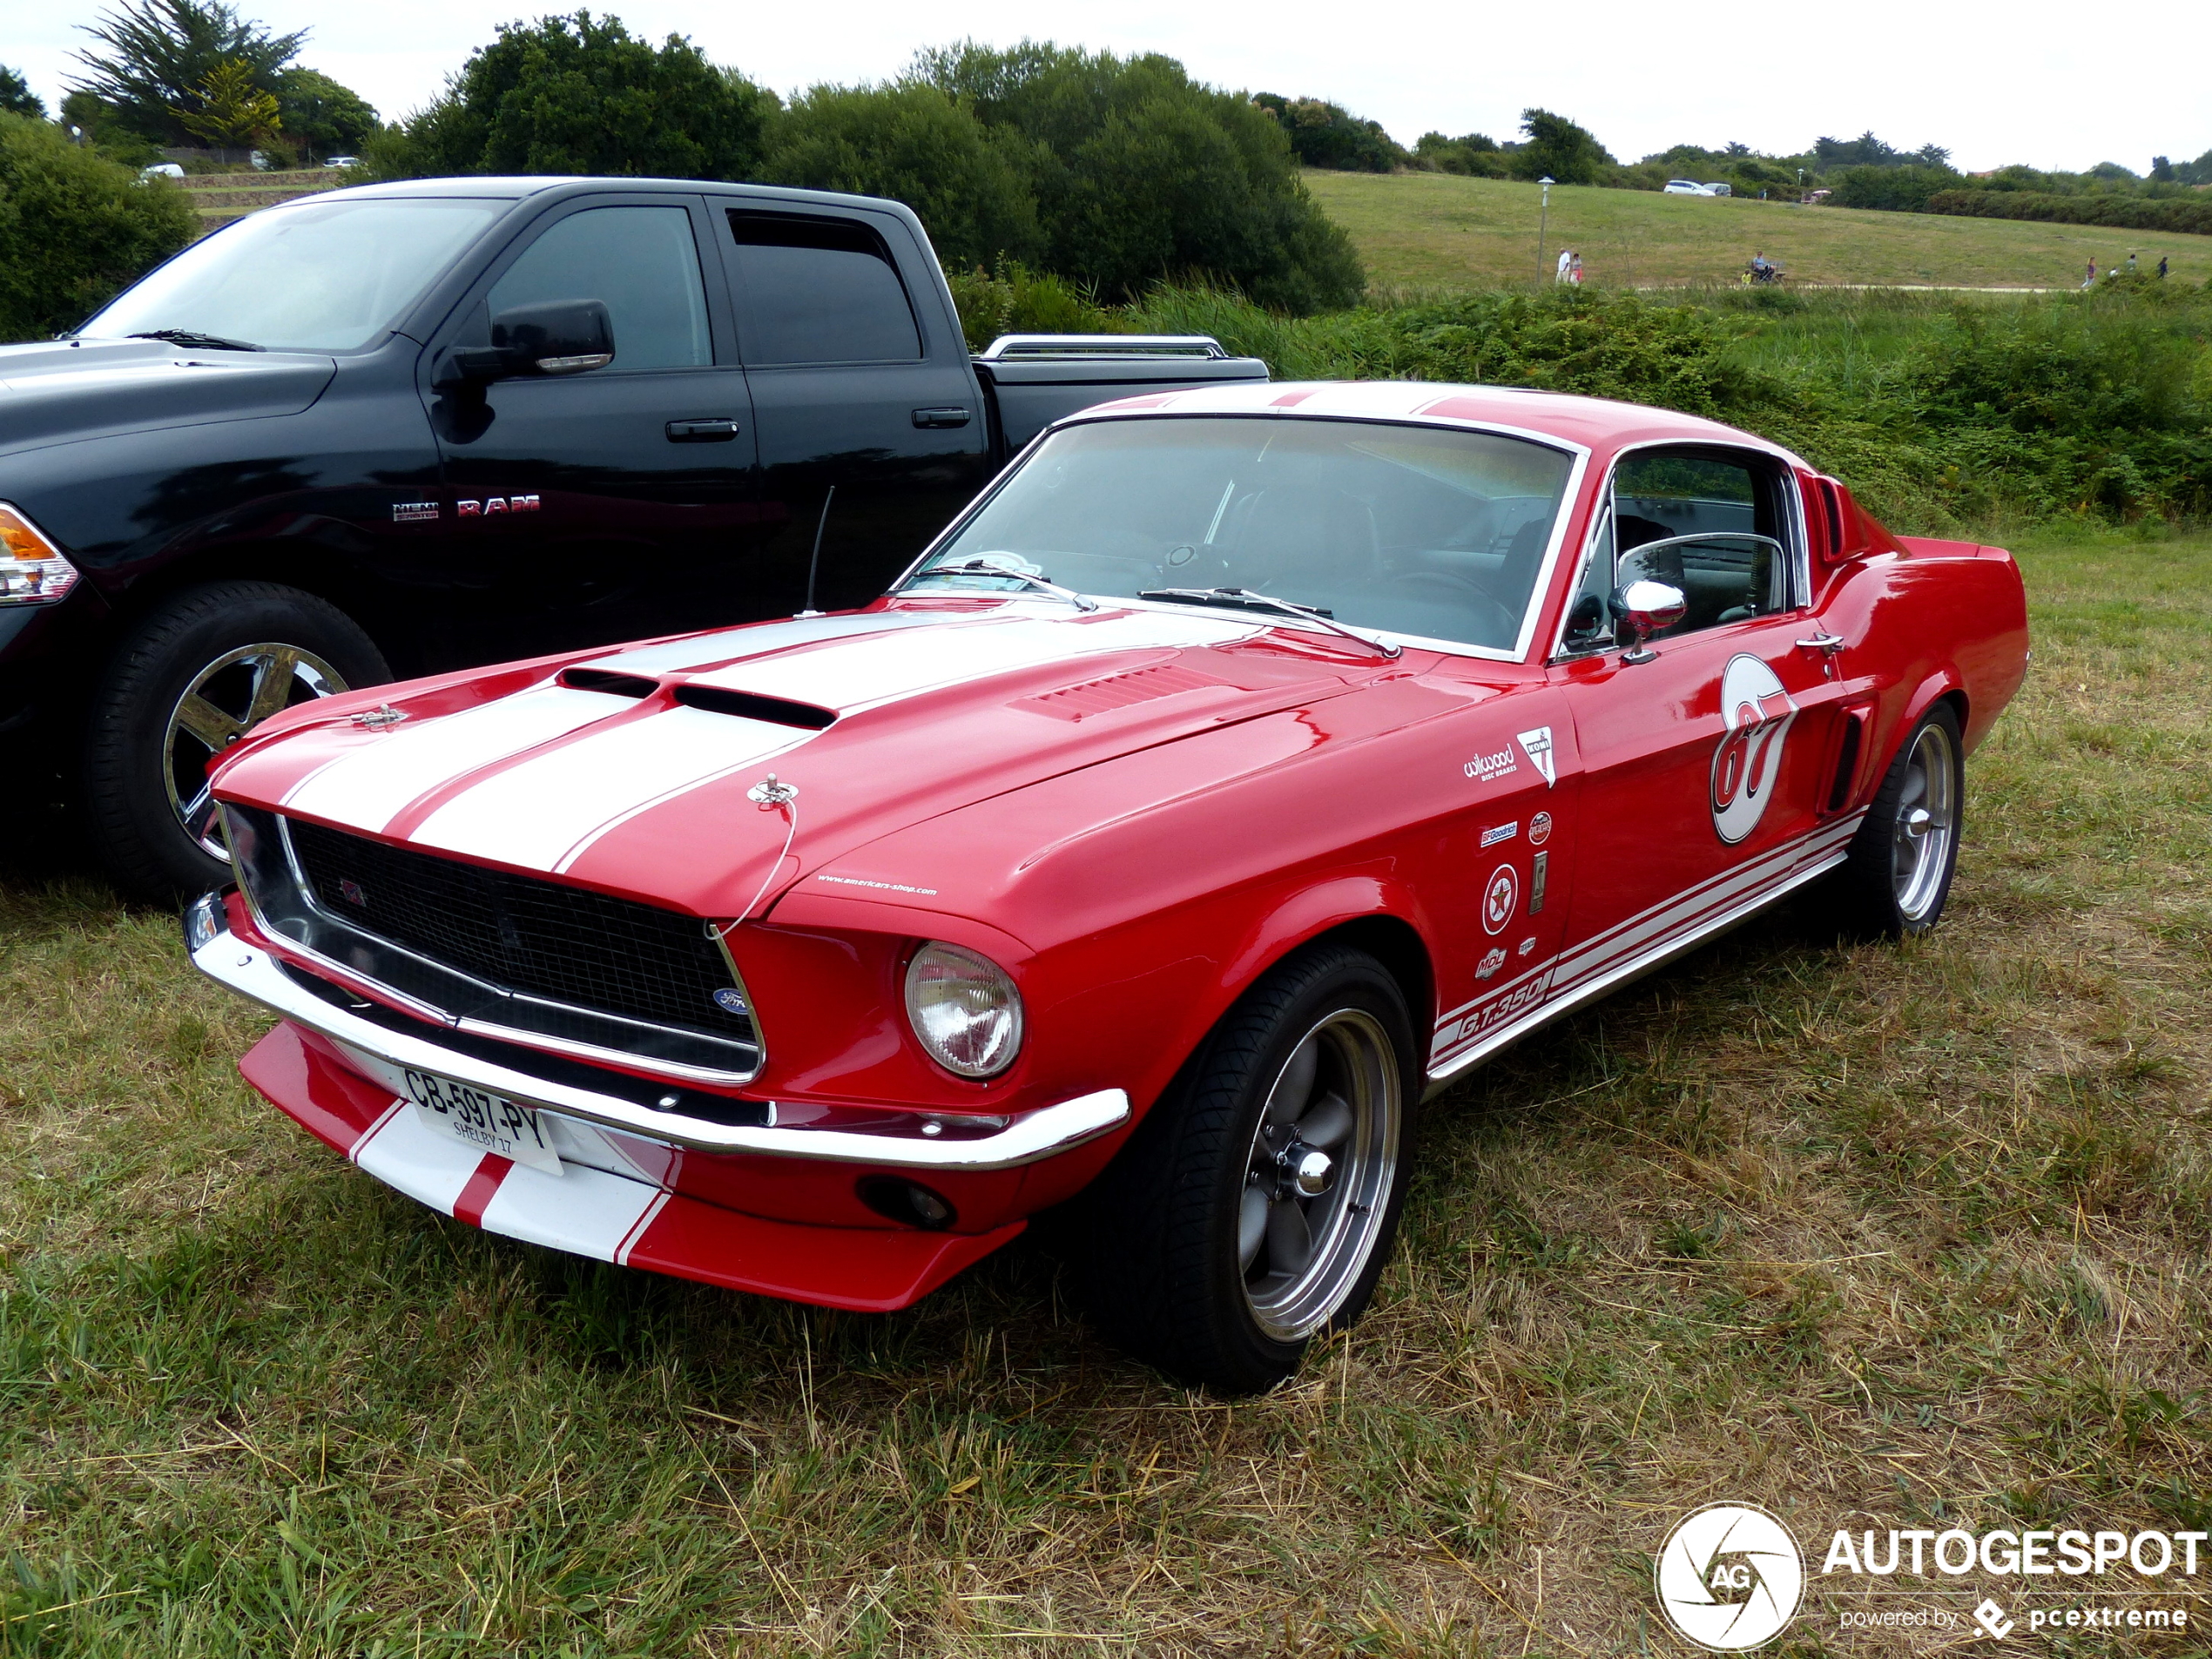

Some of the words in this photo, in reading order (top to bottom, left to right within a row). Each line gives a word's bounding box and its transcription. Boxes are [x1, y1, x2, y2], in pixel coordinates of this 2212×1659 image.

[393, 502, 439, 514] HEMI
[457, 495, 540, 517] RAM
[1527, 740, 1549, 753] KONI
[1714, 689, 1791, 813] 67
[1464, 742, 1514, 778] wilwood
[1481, 772, 1495, 782] DISC
[1495, 765, 1517, 777] BRAKES
[1482, 823, 1516, 843] BFGoodrich
[818, 873, 938, 896] www.americars-shop.com
[404, 1069, 545, 1149] CB-597-PY
[453, 1121, 496, 1148] SHELBY
[498, 1137, 511, 1154] 17
